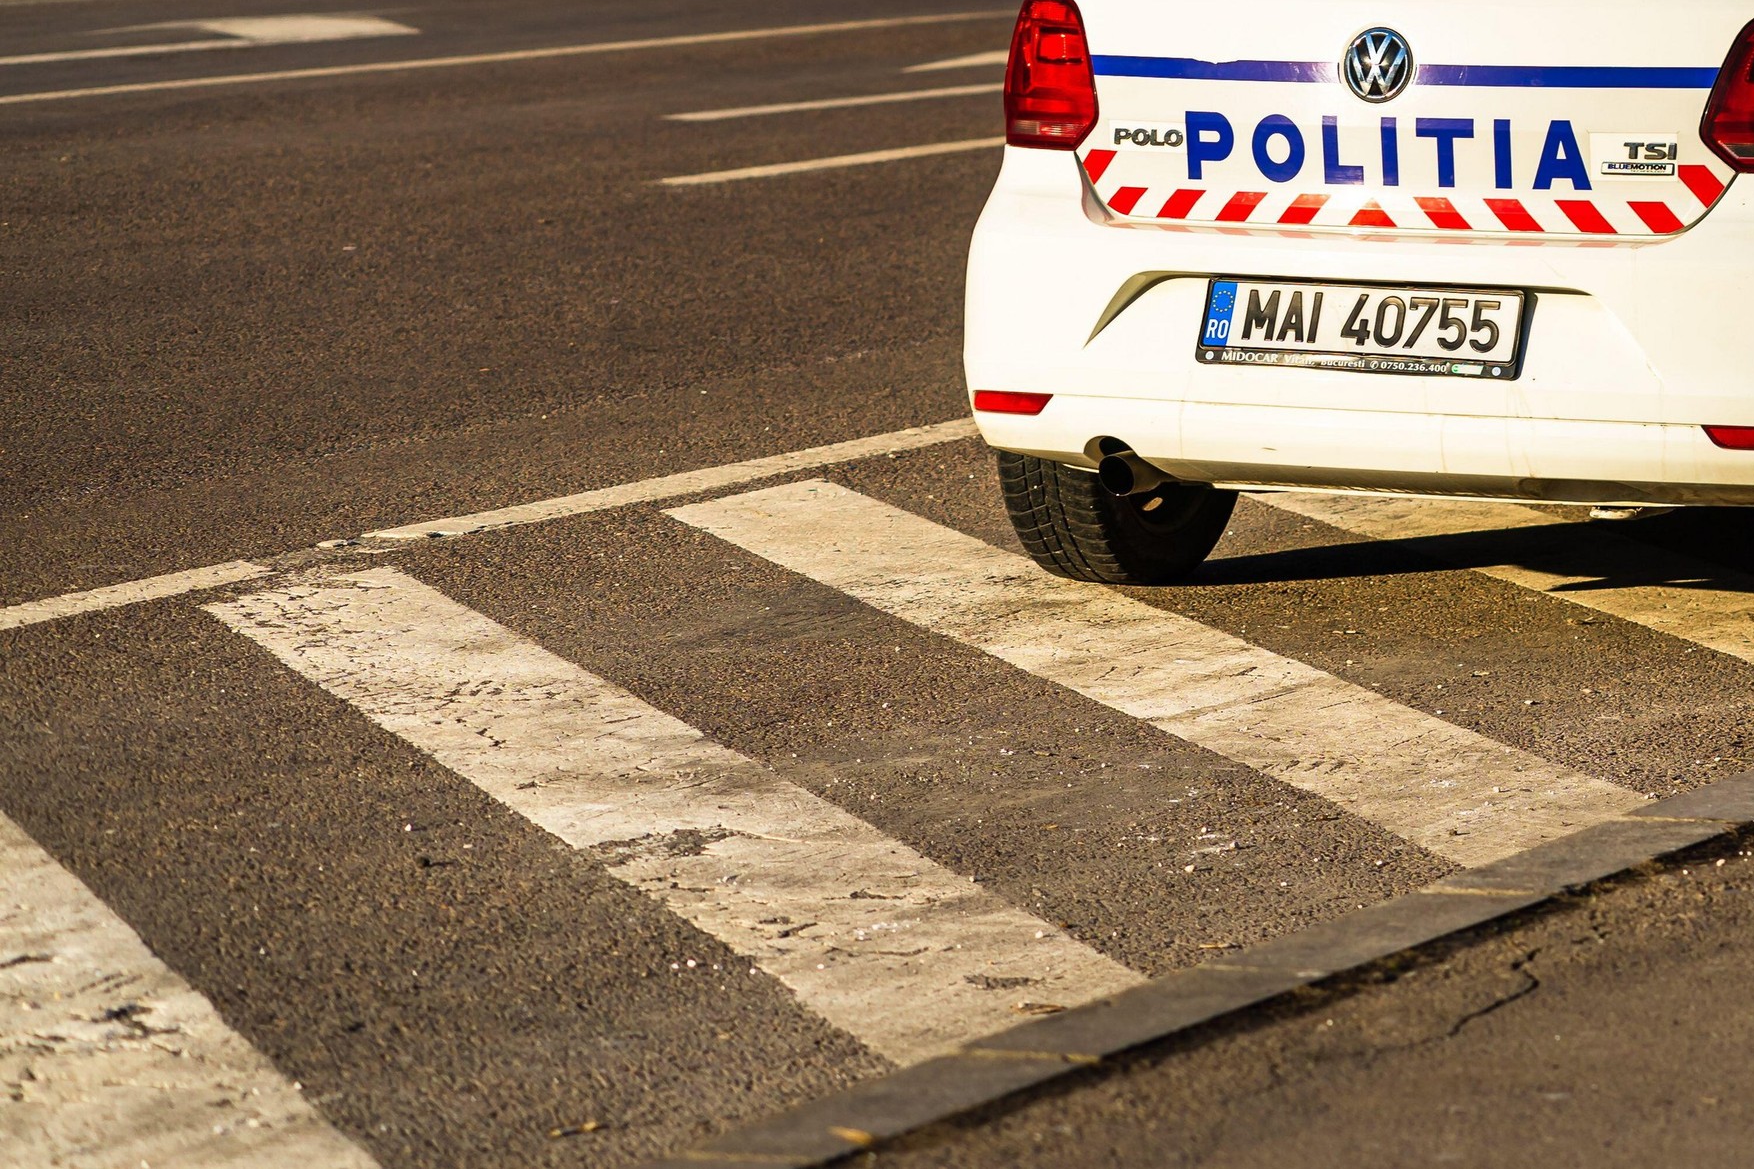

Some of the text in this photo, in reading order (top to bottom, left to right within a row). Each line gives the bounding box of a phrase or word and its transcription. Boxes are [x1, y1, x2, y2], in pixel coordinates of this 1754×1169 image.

[1114, 128, 1183, 147] POLO
[1185, 110, 1592, 191] POLITIA
[1623, 142, 1678, 161] TSI
[1607, 163, 1667, 171] BLUEMOTION
[1205, 319, 1229, 339] RO
[1241, 289, 1501, 354] MAI 40755
[1221, 350, 1279, 364] MIDOCAR
[1380, 362, 1447, 373] 0750.236.400
